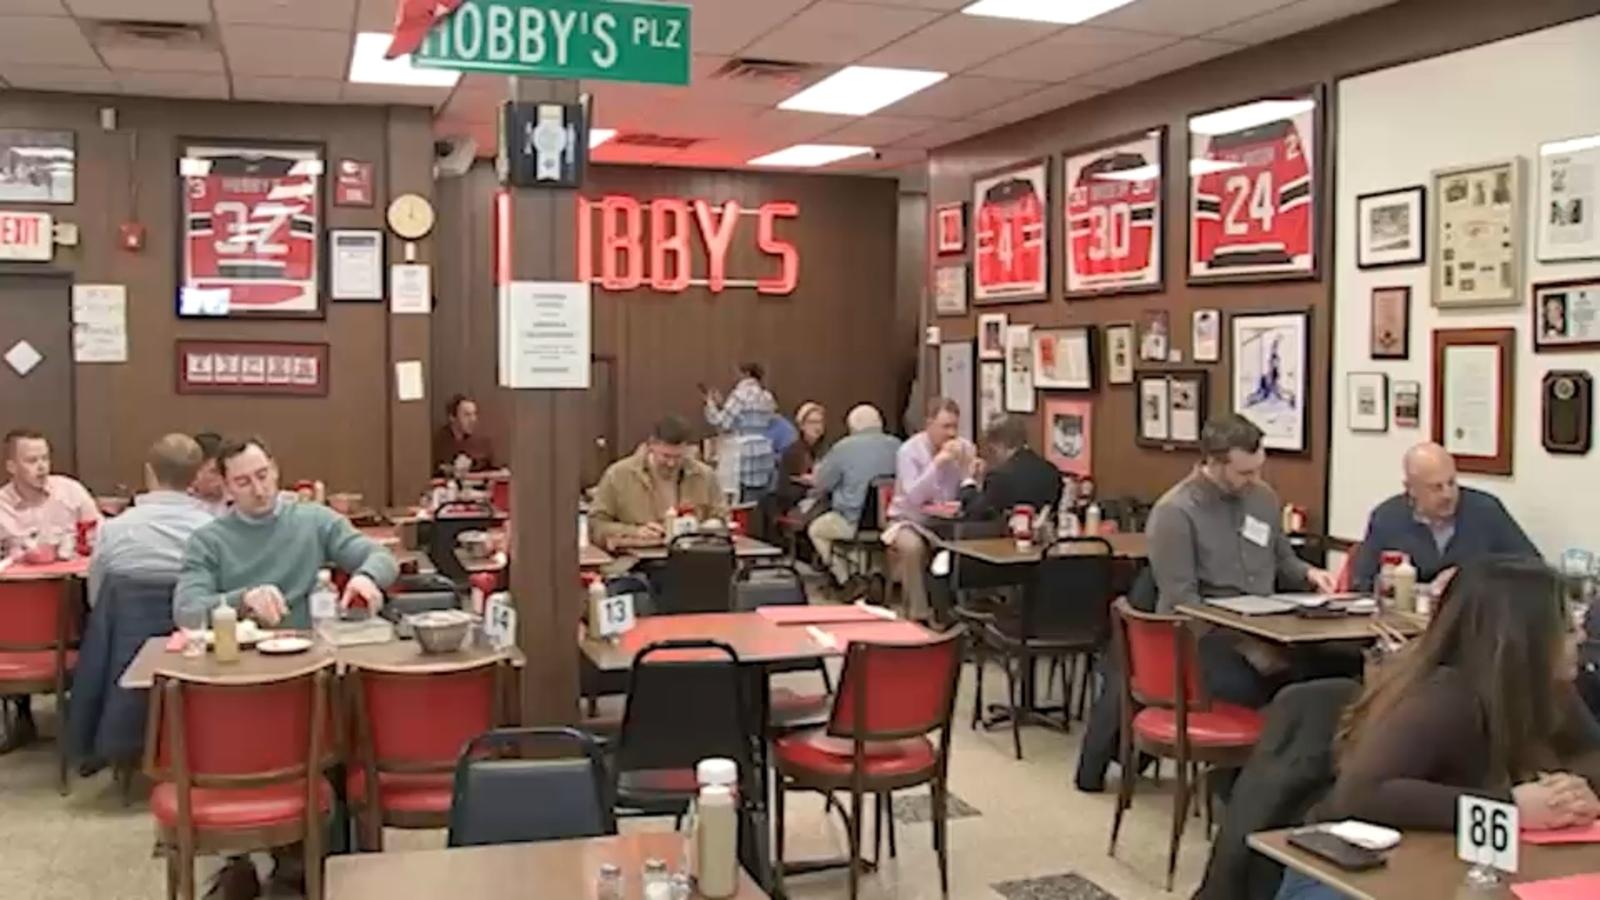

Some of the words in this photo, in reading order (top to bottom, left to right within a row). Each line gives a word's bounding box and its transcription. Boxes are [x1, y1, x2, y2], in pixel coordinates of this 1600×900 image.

[633, 17, 682, 48] PLZ
[214, 202, 289, 254] 32
[1225, 171, 1274, 235] 24
[1088, 203, 1130, 260] 30
[605, 600, 626, 623] 13
[1470, 804, 1508, 853] 86
